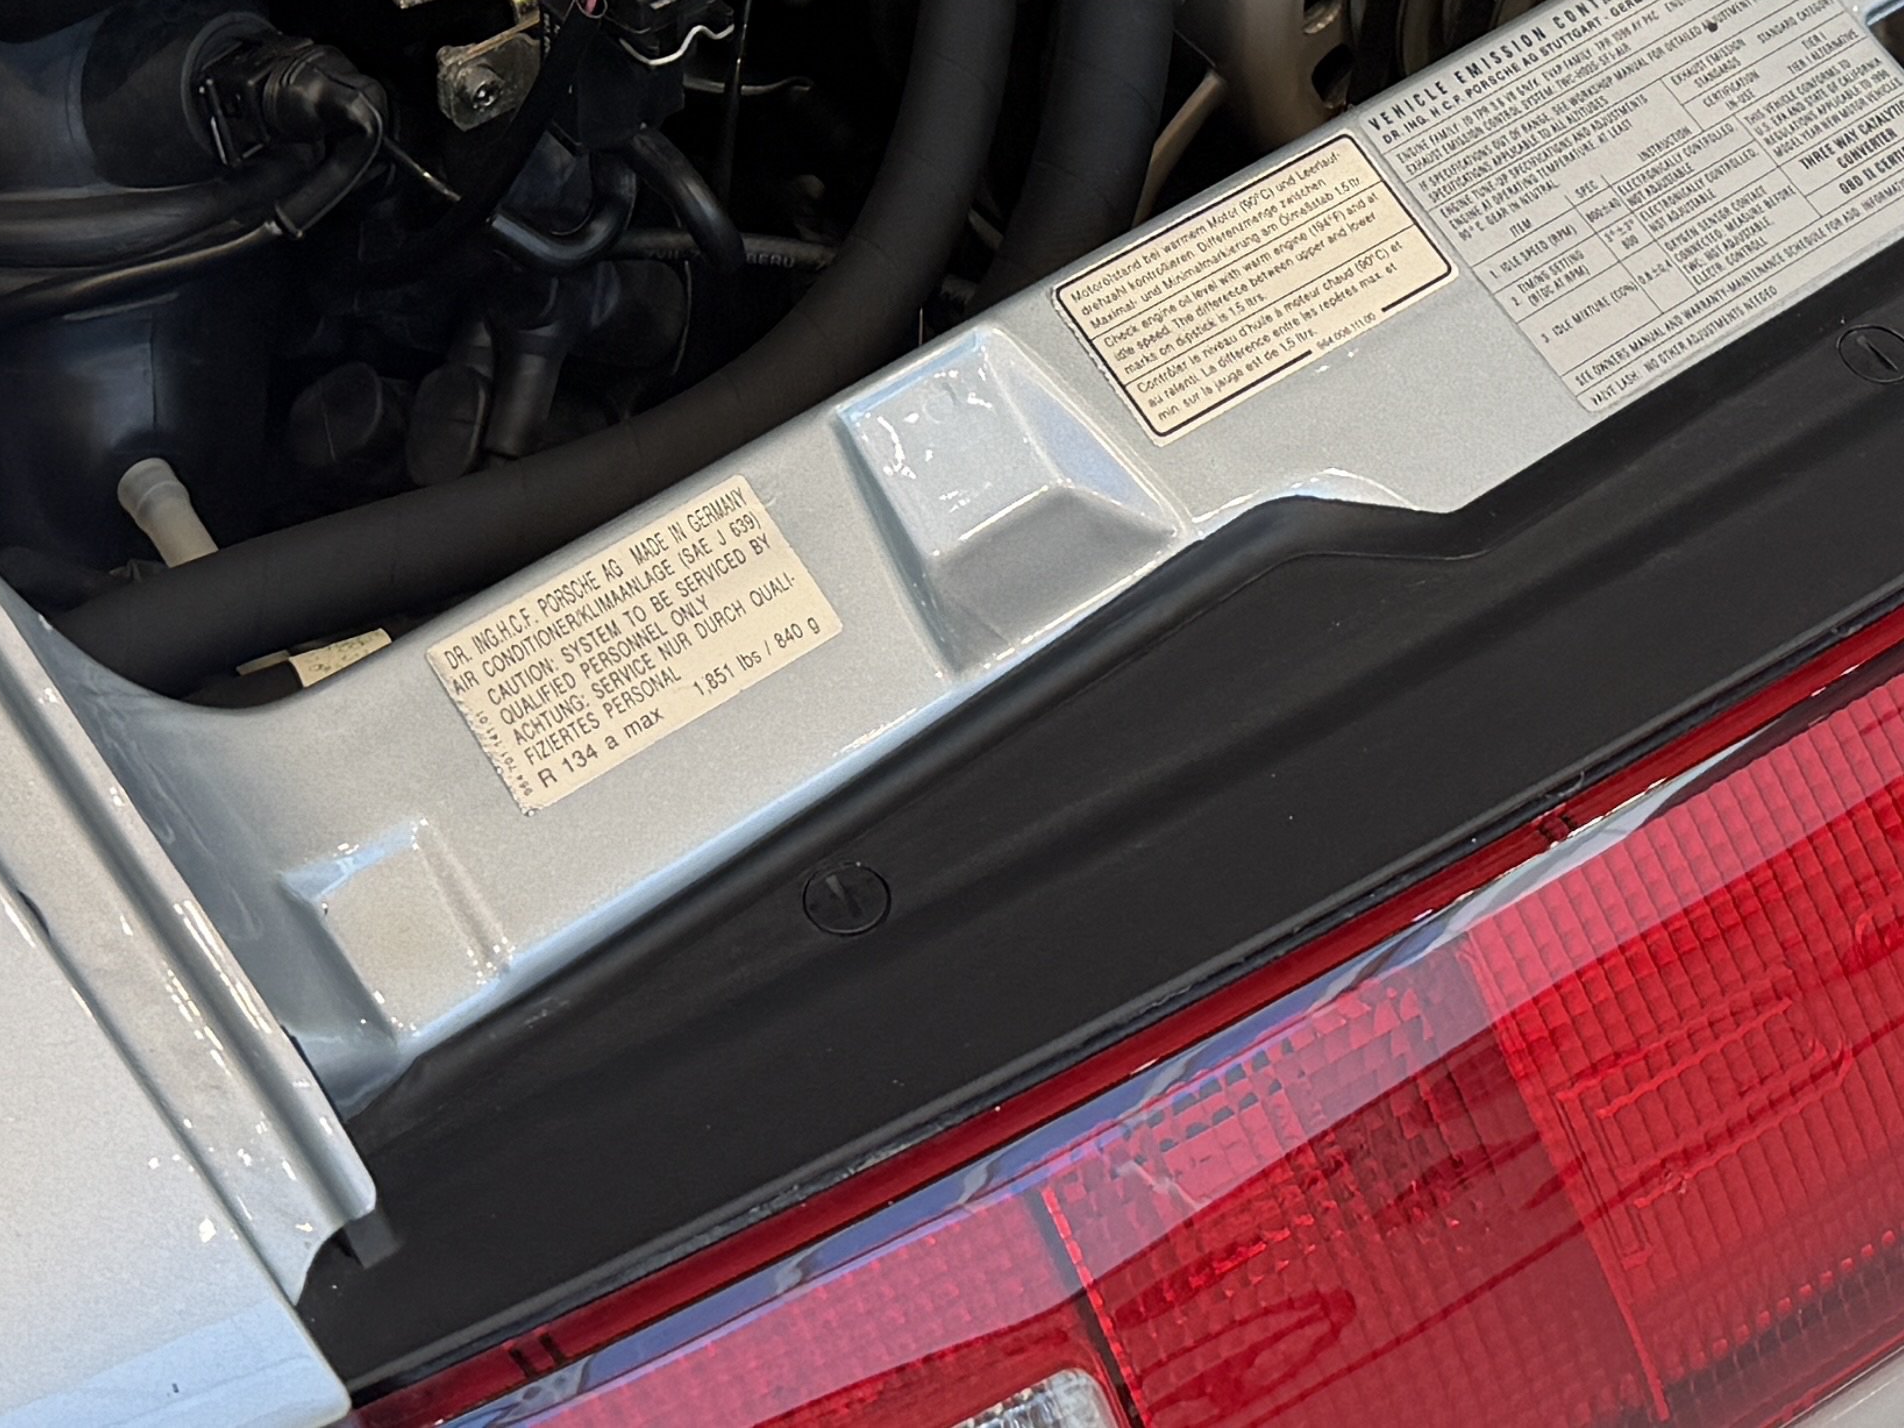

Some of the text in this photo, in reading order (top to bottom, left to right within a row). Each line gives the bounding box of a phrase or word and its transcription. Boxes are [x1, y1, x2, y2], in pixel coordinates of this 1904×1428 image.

[1368, 81, 1448, 131] VEHICLE
[1453, 26, 1547, 84] EMISSION
[1464, 62, 1521, 99] PORSCHE
[1521, 52, 1539, 67] AG
[1539, 16, 1602, 57] STUTTGART
[1275, 174, 1297, 192] und
[1798, 143, 1836, 170] THREE
[1833, 129, 1859, 150] WAY
[1836, 128, 1898, 169] CONVERTER
[1838, 175, 1864, 195] OBD
[1103, 325, 1140, 348] Check
[1141, 304, 1178, 329] engine
[1178, 294, 1193, 308] oil
[1191, 280, 1218, 300] level
[1218, 269, 1242, 286] with
[1242, 252, 1272, 272] warm
[1273, 232, 1308, 256] engine
[1346, 198, 1367, 216] and
[1367, 192, 1378, 204] at
[1140, 284, 1163, 303] und
[1260, 223, 1279, 237] am
[1171, 313, 1195, 329] The
[1248, 258, 1294, 288] between
[1295, 239, 1325, 262] upper
[1327, 227, 1348, 244] and
[1346, 211, 1376, 232] lower
[1188, 354, 1202, 365] le
[1202, 334, 1238, 358] niveau
[1283, 286, 1321, 313] moteur
[1322, 267, 1355, 291] chaud
[1390, 240, 1403, 253] et
[1123, 352, 1158, 375] marks
[1158, 343, 1175, 356] on
[1175, 319, 1217, 347] dipstick
[1217, 312, 1229, 323] is
[1200, 364, 1218, 378] La
[1272, 318, 1301, 338] entre
[1299, 308, 1318, 321] les
[1385, 262, 1398, 274] et
[1182, 392, 1200, 408] sur
[1200, 386, 1214, 396] la
[1245, 356, 1264, 372] est
[1263, 349, 1279, 361] de
[443, 645, 473, 670] DR.
[536, 570, 601, 618] PORSCHE
[601, 558, 624, 582] AG
[628, 531, 670, 566] MADE
[667, 521, 688, 544] IN
[686, 487, 747, 533] GERMANY
[452, 511, 762, 696] AIR CONDITIONER/KLIMAANLAGE (SAE J 639)
[487, 533, 771, 706] CAUTION: SYSTEM TO BE SERVICED BY
[499, 594, 709, 726] QUALIFIED PERSONNEL ONLY
[512, 572, 795, 746] ACHTUNG: SERVICE NUR DURCH QUALI-
[537, 767, 558, 788] R
[562, 743, 598, 773] 134
[604, 735, 620, 750] a
[623, 708, 664, 739] max
[693, 663, 735, 696] 1,851
[735, 650, 762, 671] lbs
[773, 623, 804, 649] 840
[807, 617, 821, 635] g
[523, 666, 682, 766] FIZIERTES PERSONAL
